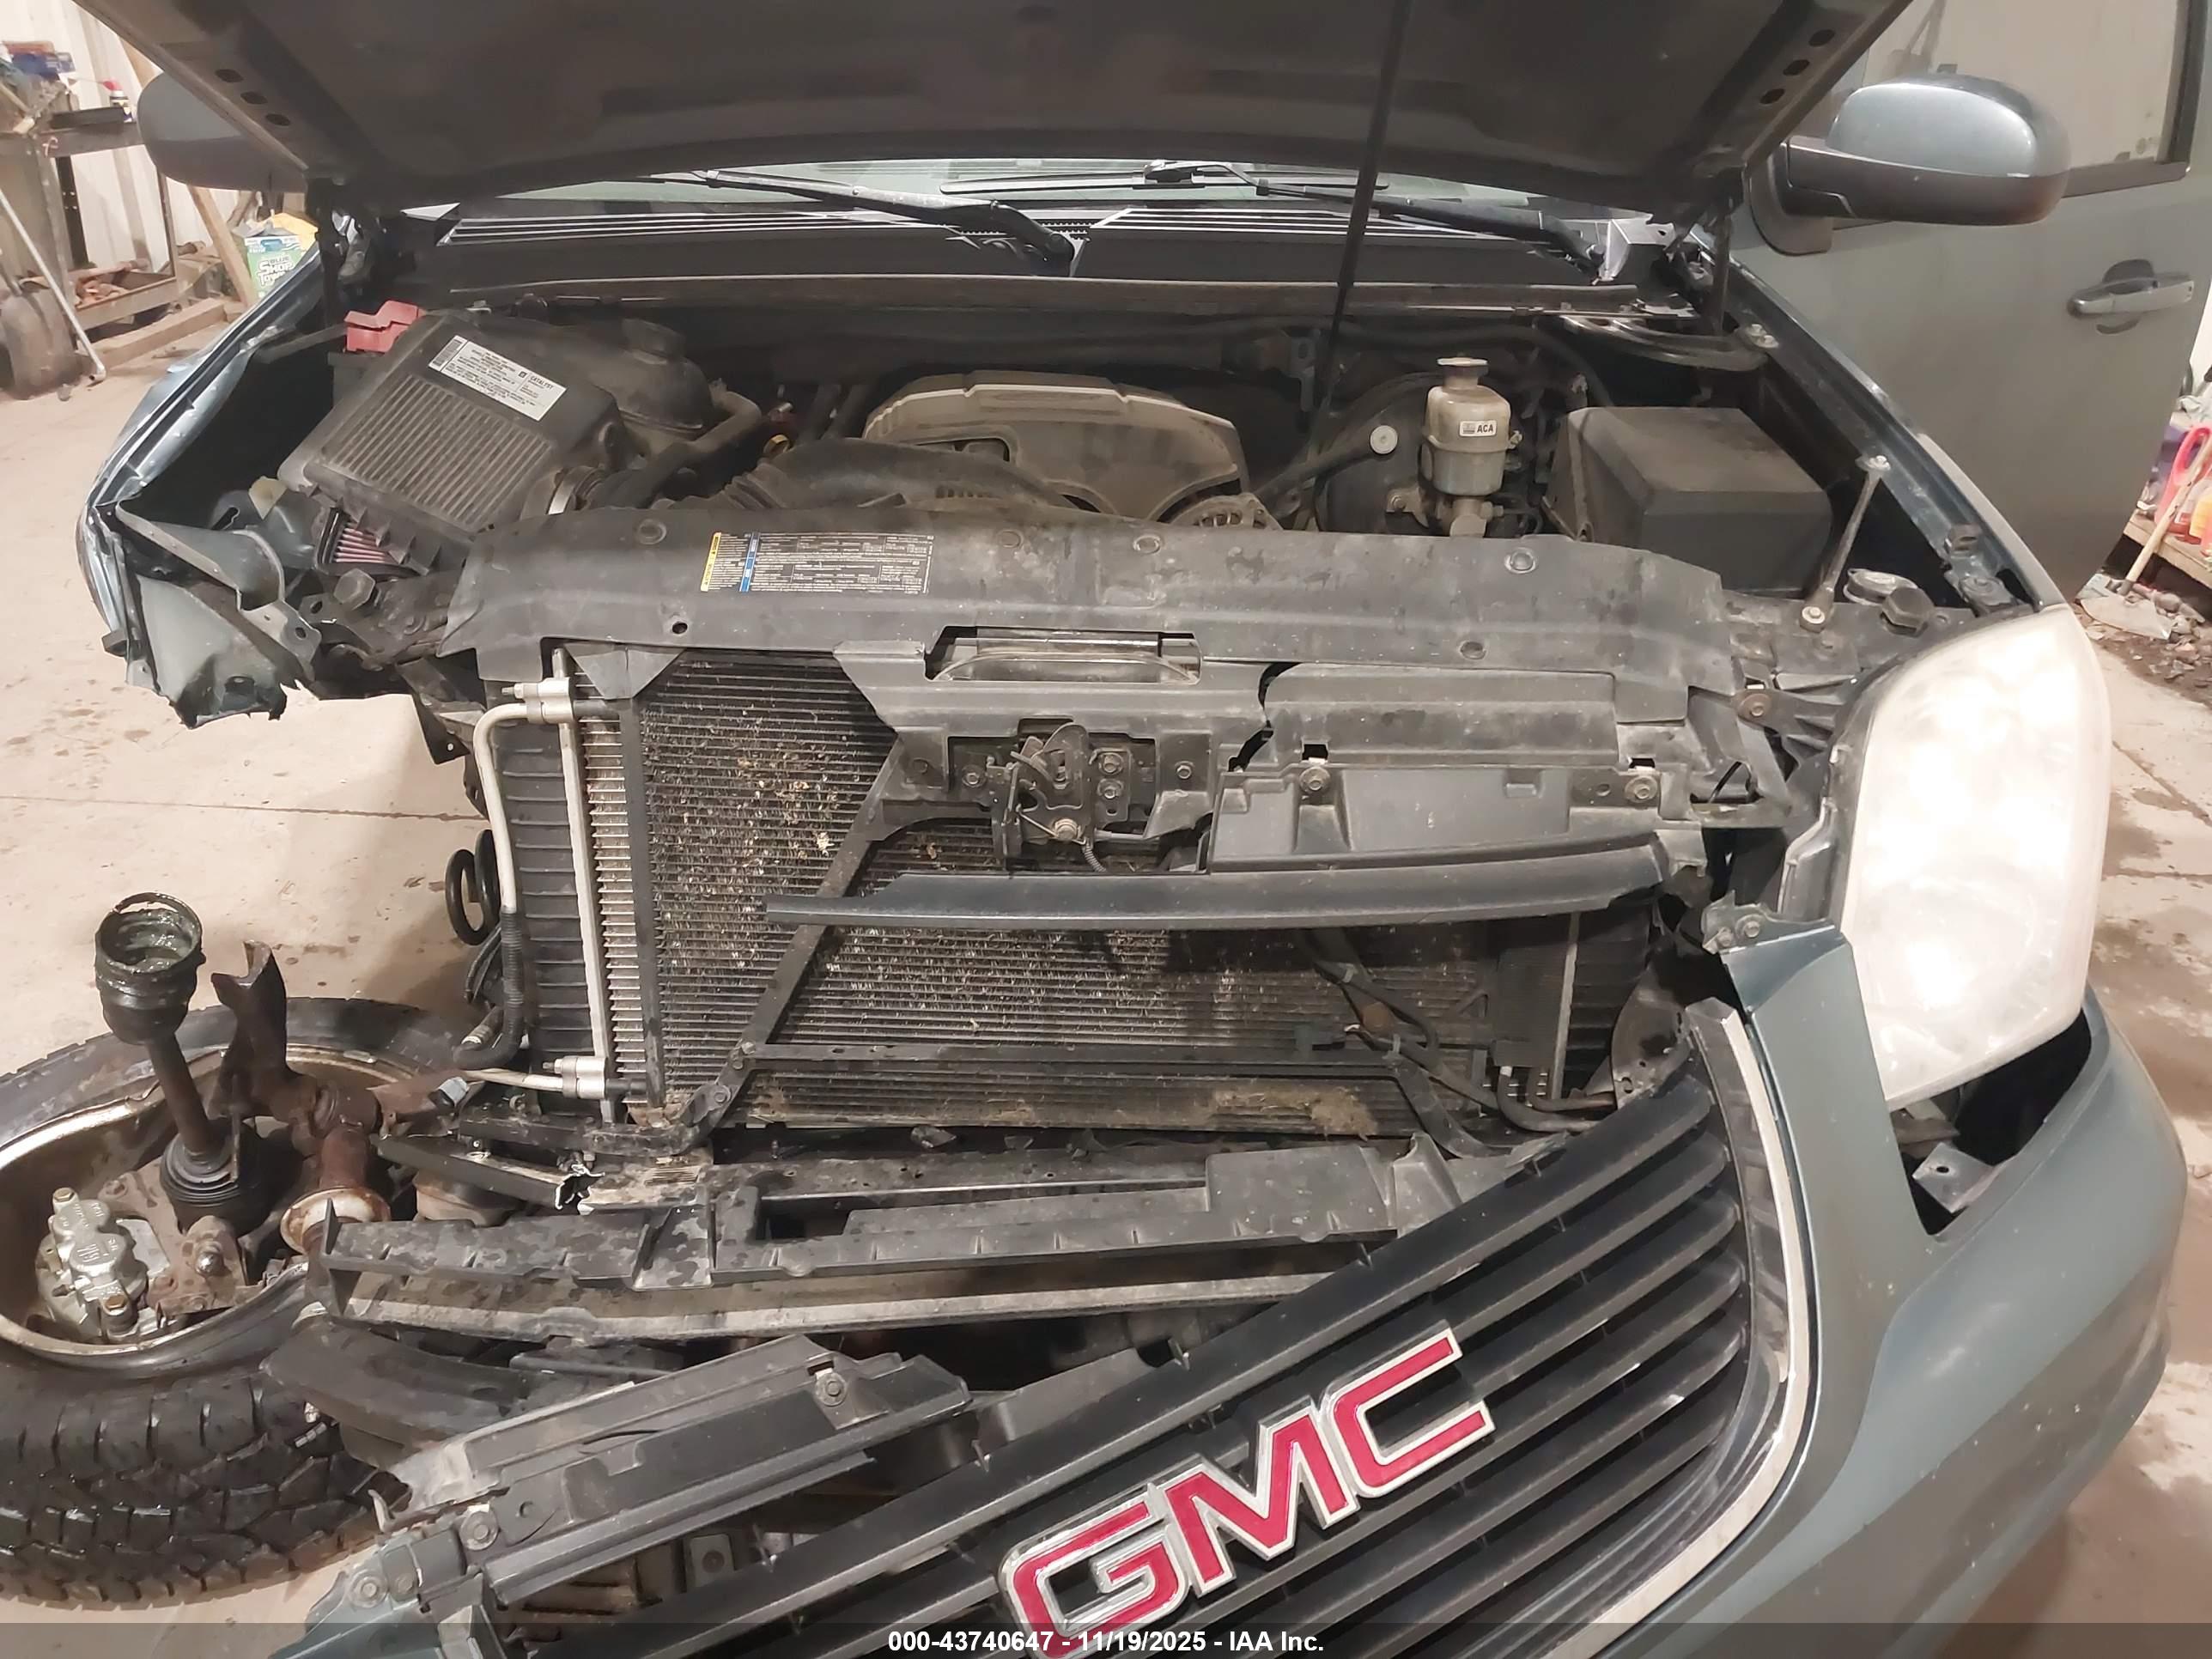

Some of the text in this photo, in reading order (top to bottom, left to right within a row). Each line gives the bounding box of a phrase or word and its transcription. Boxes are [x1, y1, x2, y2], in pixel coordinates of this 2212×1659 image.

[258, 260, 293, 275] SHOP
[1477, 424, 1493, 433] ACA
[1002, 1327, 1496, 1658] GMC
